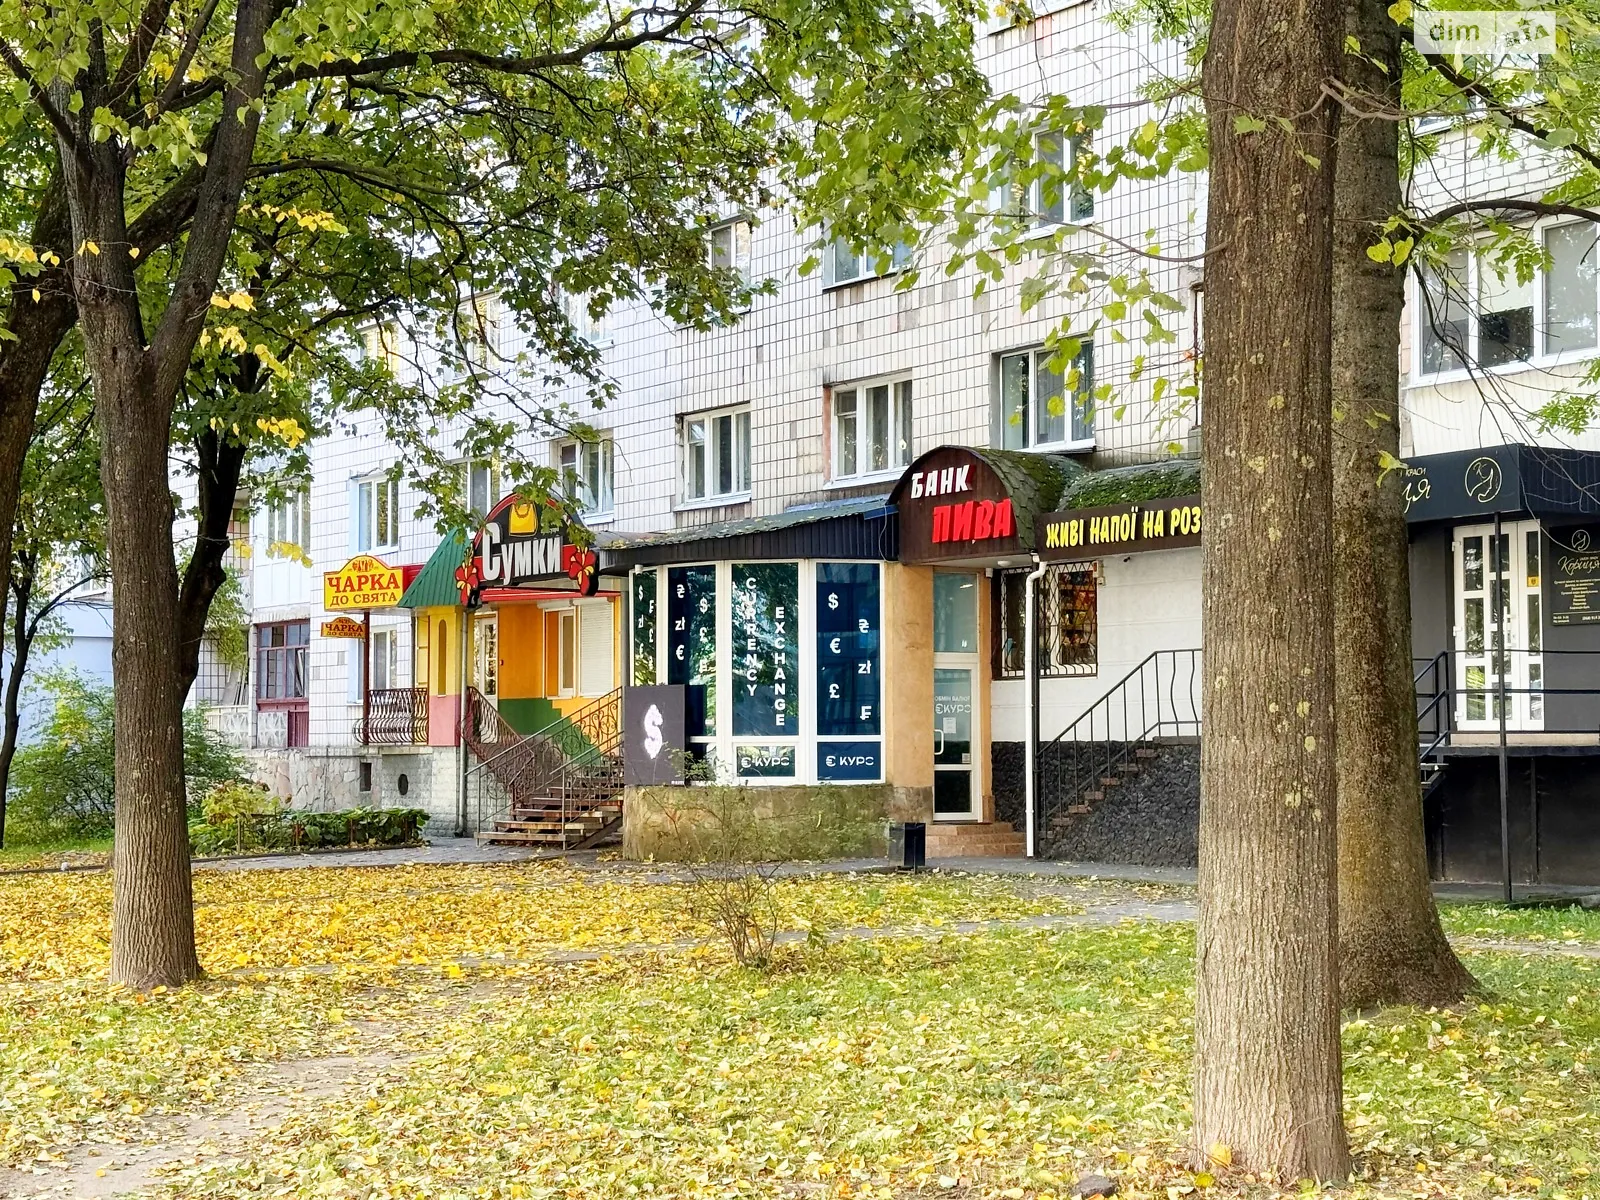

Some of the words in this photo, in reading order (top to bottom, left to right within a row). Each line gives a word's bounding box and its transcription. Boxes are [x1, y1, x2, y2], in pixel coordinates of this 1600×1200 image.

[910, 464, 971, 499] БАНК
[932, 498, 1012, 544] ПИВА
[1045, 518, 1085, 549] ЖИВІ
[1089, 505, 1139, 545] НАПОЇ
[1143, 509, 1164, 539] НА
[482, 522, 561, 586] Сумки
[327, 572, 401, 594] ЧАРКА
[330, 595, 349, 607] ДО
[353, 592, 398, 604] СВЯТА
[325, 623, 364, 632] ЧАРКА
[745, 577, 758, 697] CURRENCY
[774, 606, 786, 727] EXCHANGE
